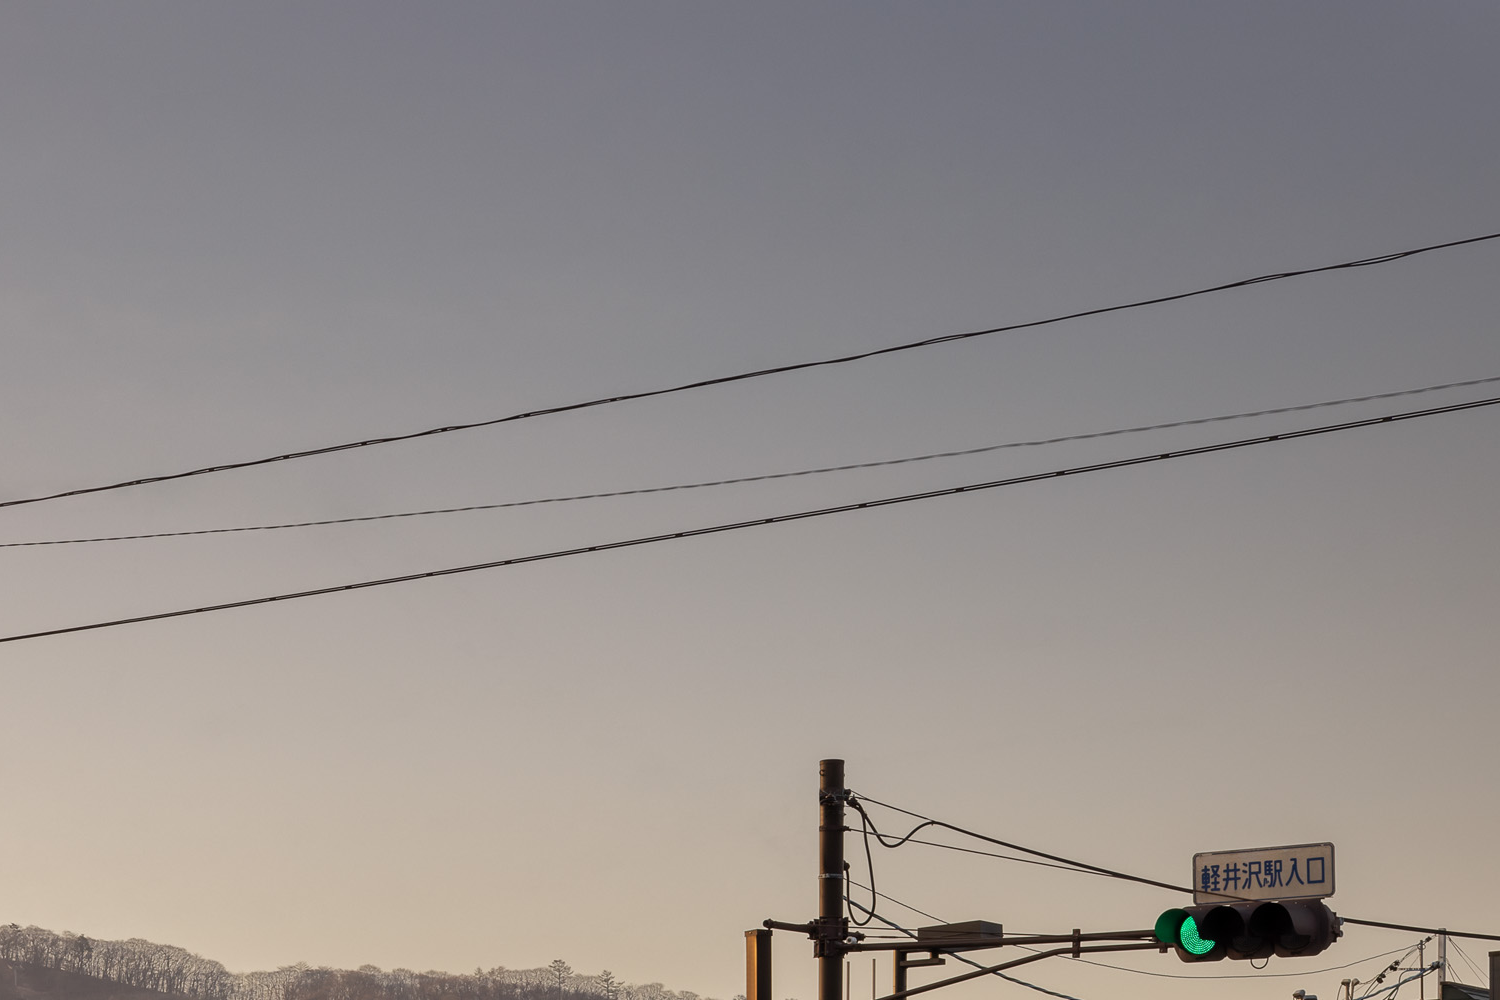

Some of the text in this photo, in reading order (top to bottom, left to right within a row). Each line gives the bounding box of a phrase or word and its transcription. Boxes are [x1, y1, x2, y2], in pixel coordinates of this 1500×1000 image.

[1201, 857, 1325, 892] 軽井沢駅入口
